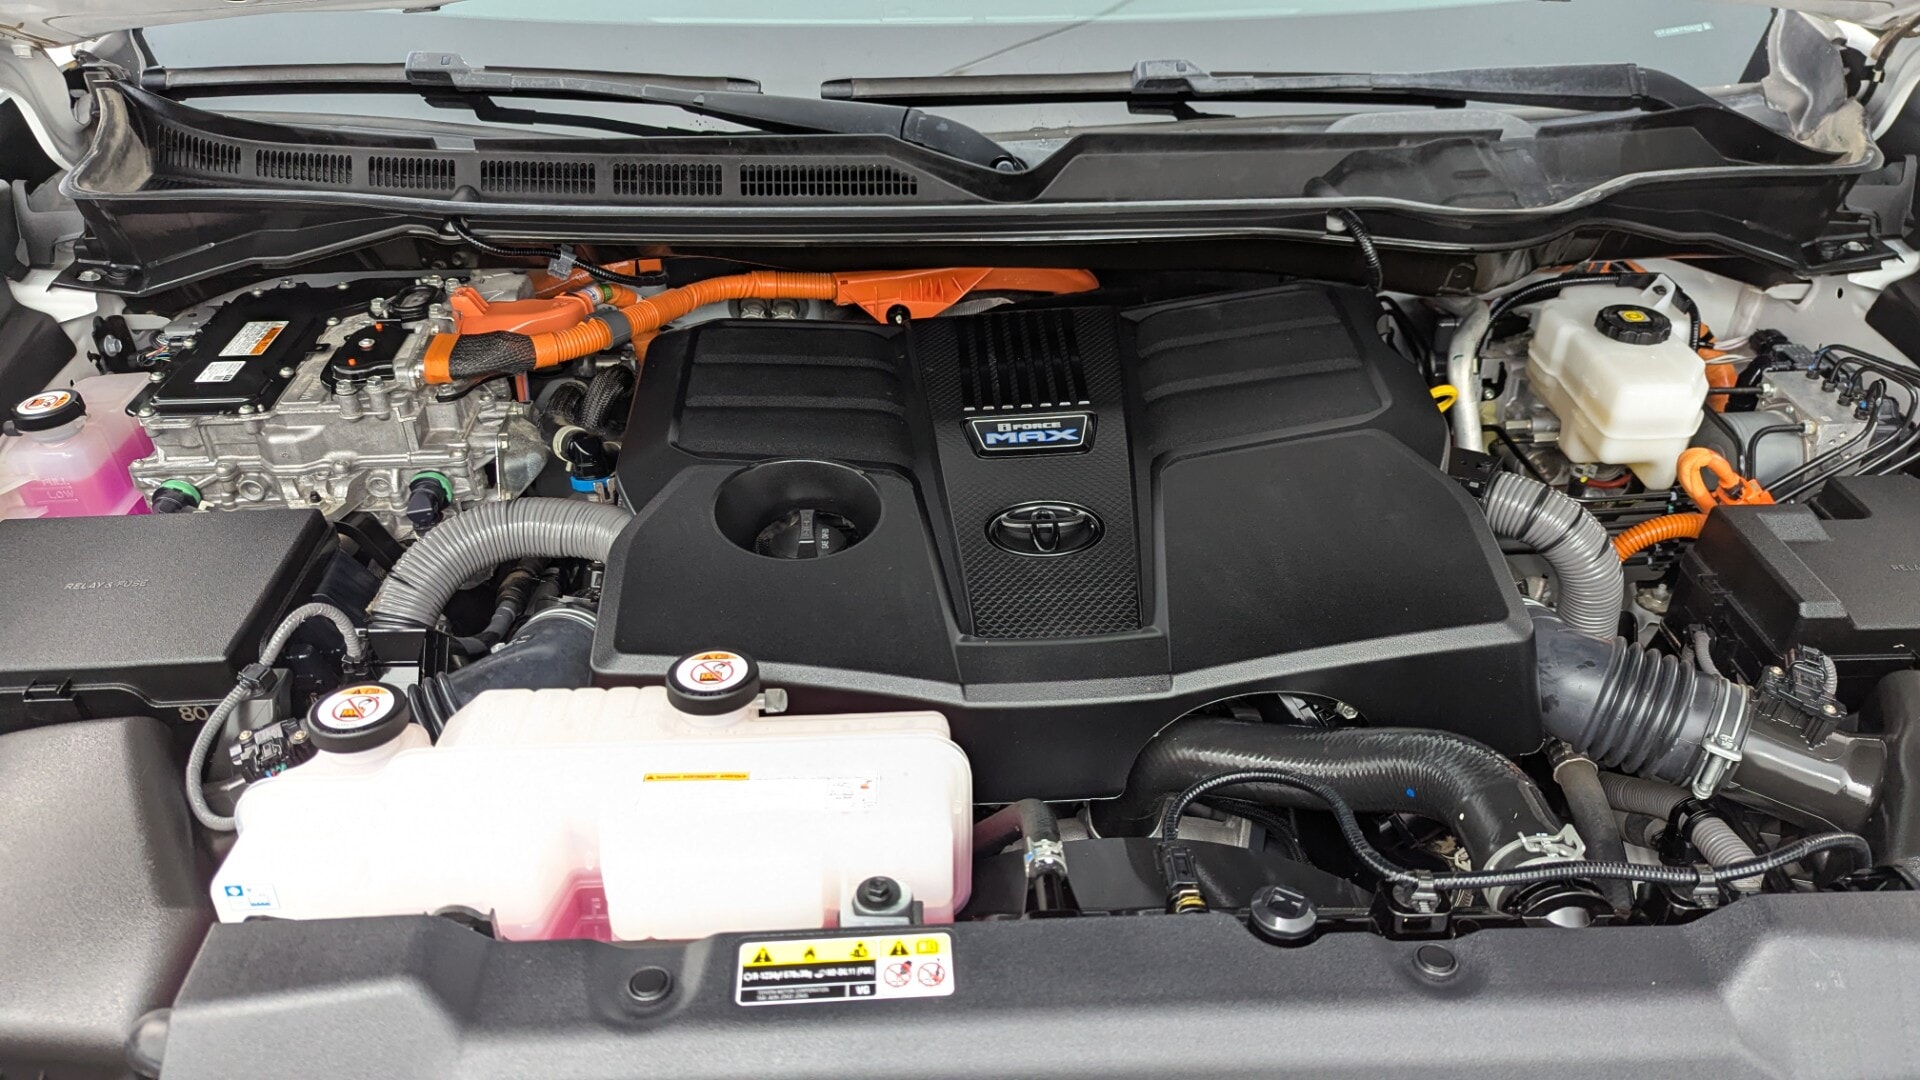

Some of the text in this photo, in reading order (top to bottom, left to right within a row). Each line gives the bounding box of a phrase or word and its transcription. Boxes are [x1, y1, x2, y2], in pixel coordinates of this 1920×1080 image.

[986, 429, 1079, 445] MAX
[46, 489, 74, 499] LOW
[63, 581, 105, 590] RELAY
[115, 579, 149, 588] FUSE
[178, 706, 209, 721] 80
